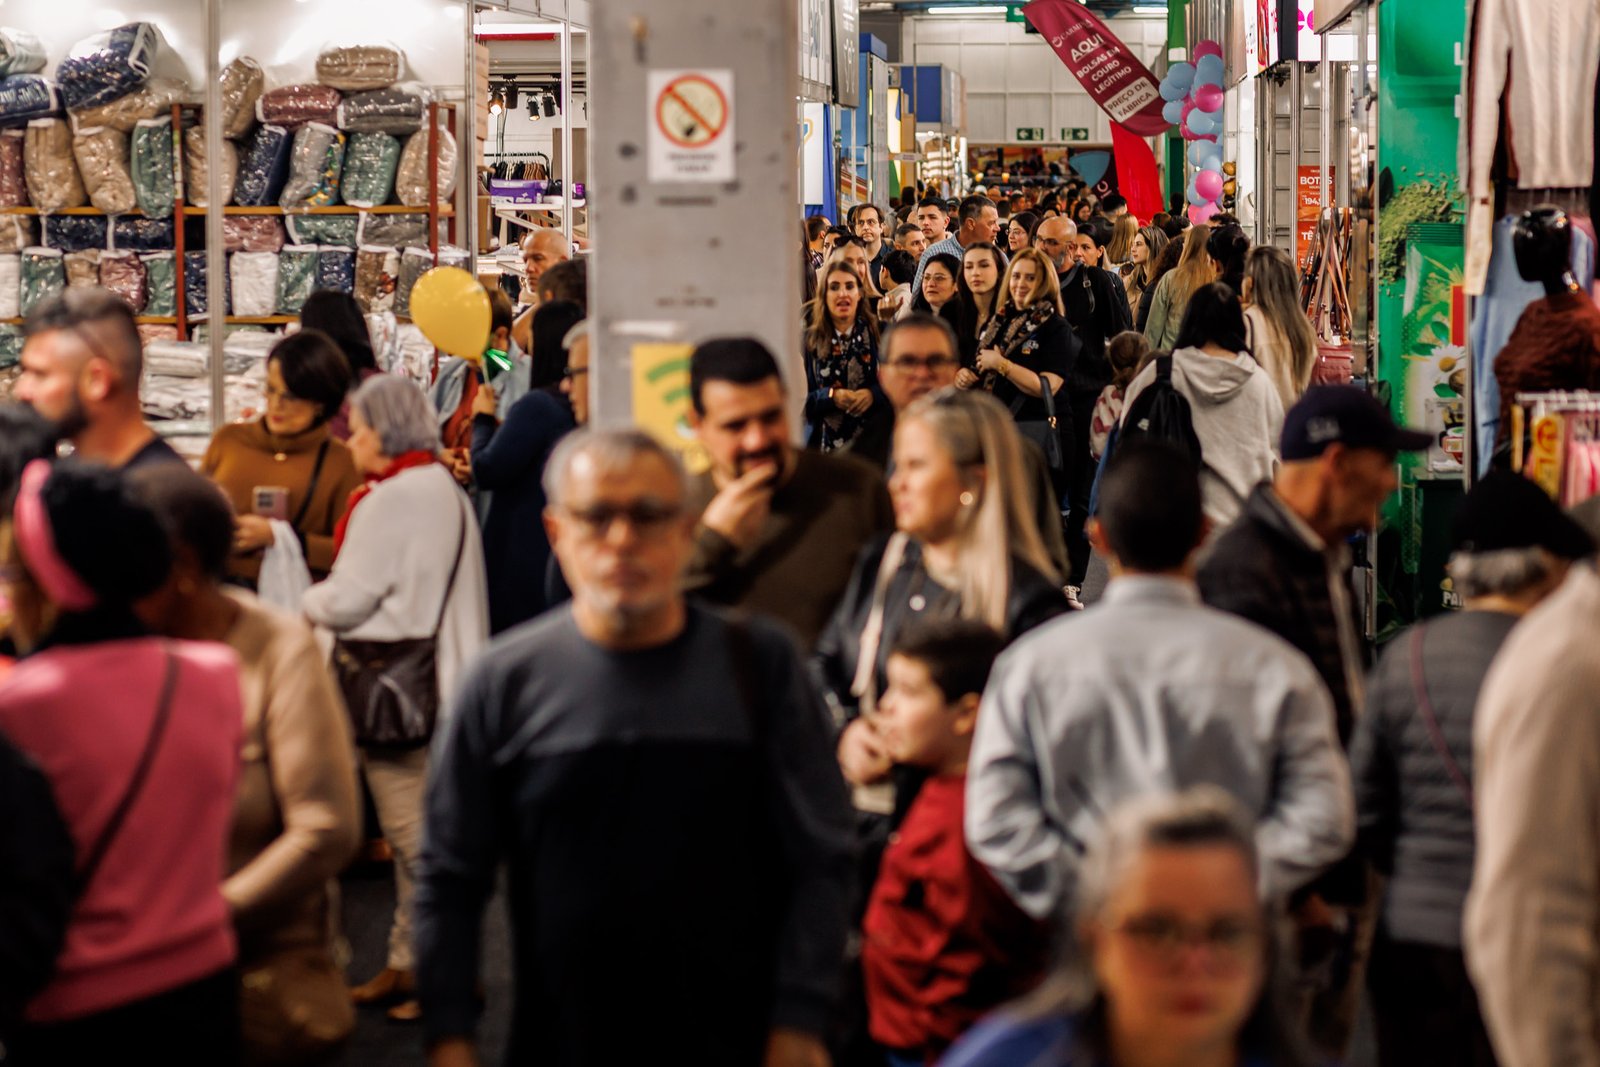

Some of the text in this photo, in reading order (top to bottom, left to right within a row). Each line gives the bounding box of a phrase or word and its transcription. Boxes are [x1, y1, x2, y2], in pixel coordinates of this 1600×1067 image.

[1070, 33, 1105, 63] AQUI
[1076, 46, 1121, 78] BOLSAS EM
[1091, 59, 1120, 82] COURO
[1094, 66, 1132, 94] LEGÍTIMO
[1107, 80, 1148, 111] PREÇO DE
[1117, 91, 1153, 117] FÁBRICA
[1300, 176, 1333, 185] BOTS
